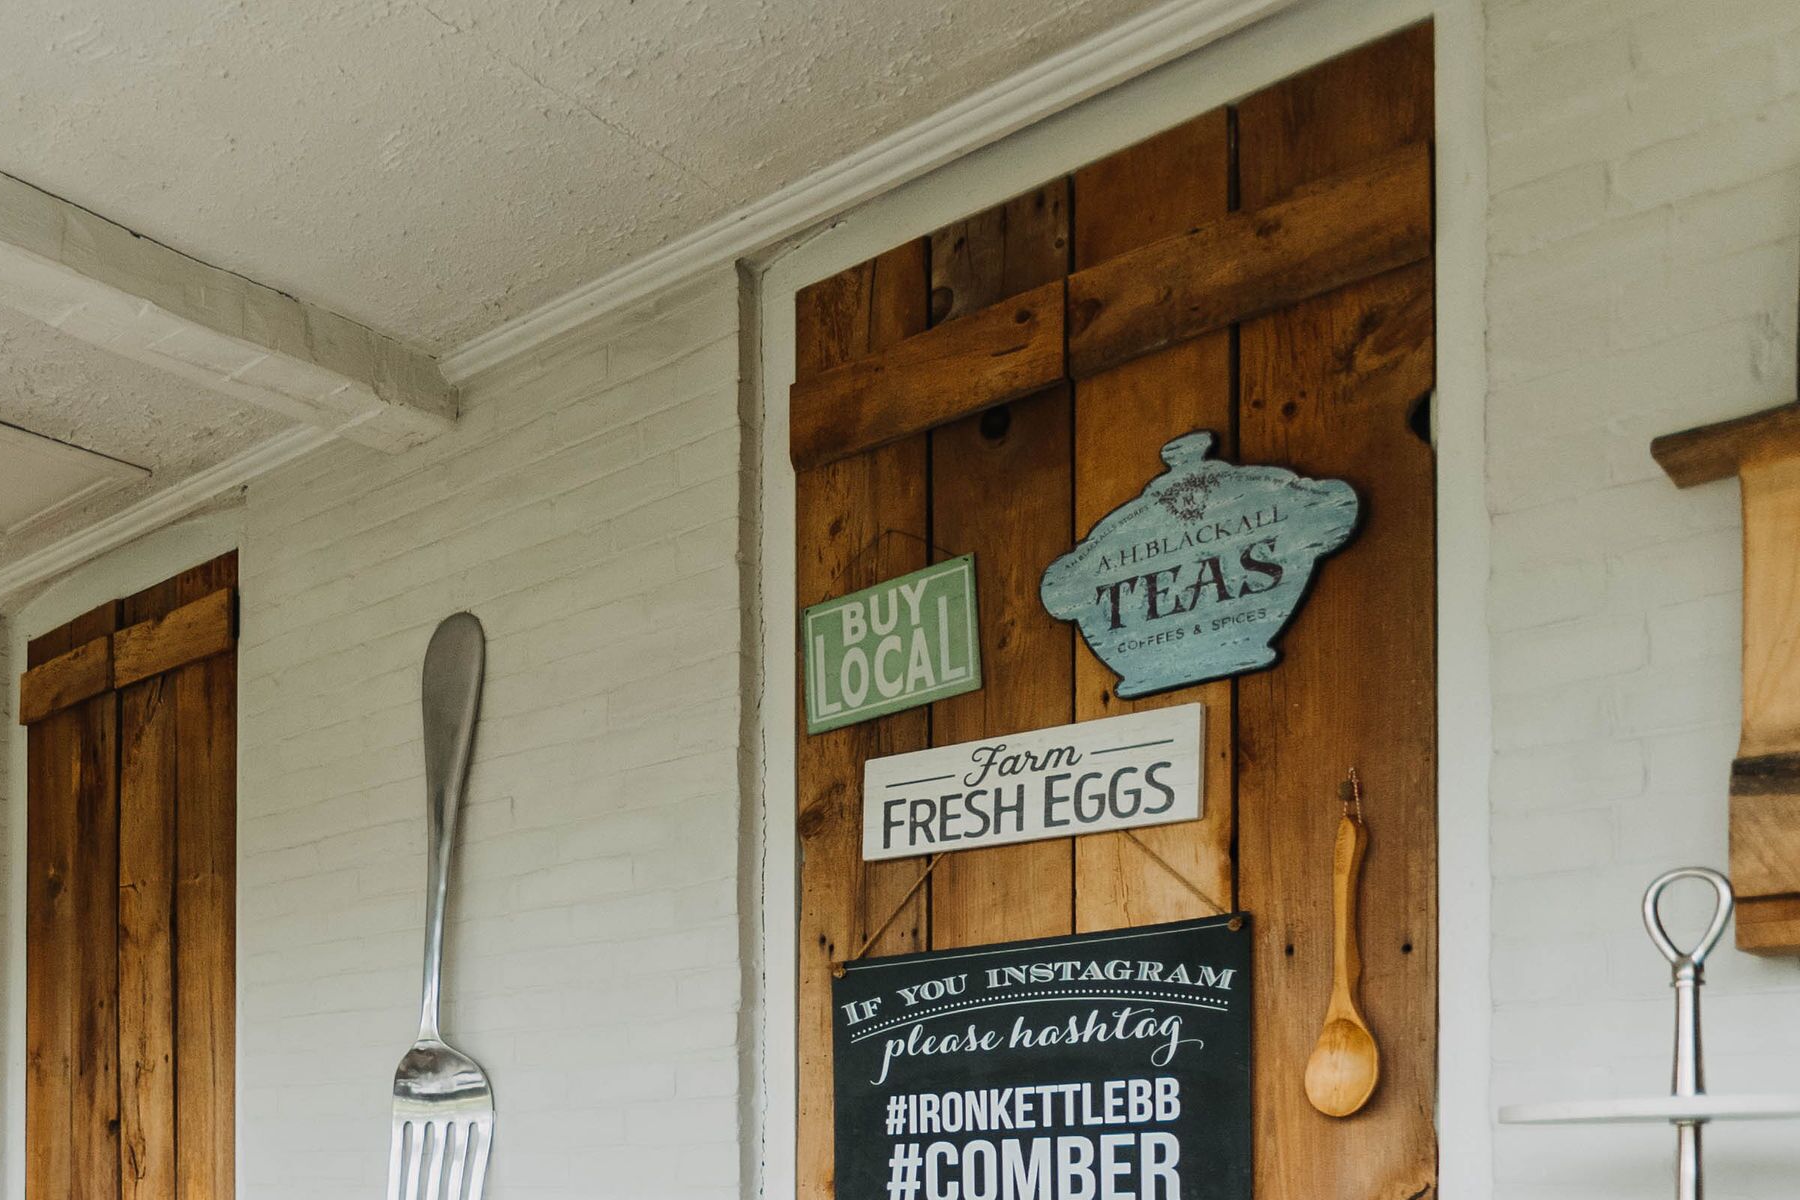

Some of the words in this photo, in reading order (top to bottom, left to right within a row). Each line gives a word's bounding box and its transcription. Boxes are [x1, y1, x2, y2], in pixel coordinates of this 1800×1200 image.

[841, 577, 929, 647] BUY
[1095, 535, 1284, 632] TEAS
[815, 595, 967, 717] LOCAL
[1117, 628, 1185, 654] COFFEES
[1193, 624, 1203, 636] &
[1211, 608, 1267, 632] SPICES
[963, 743, 1083, 788] Farm
[882, 783, 1025, 850] FRESH
[1043, 761, 1176, 829] EGGS
[841, 997, 882, 1026] IF
[896, 973, 968, 1007] YOU
[986, 959, 1237, 991] INSTAGRAM
[869, 1024, 1004, 1086] please
[1008, 1007, 1204, 1067] hashtag
[885, 1077, 1181, 1136] #IRONKETTLEBB
